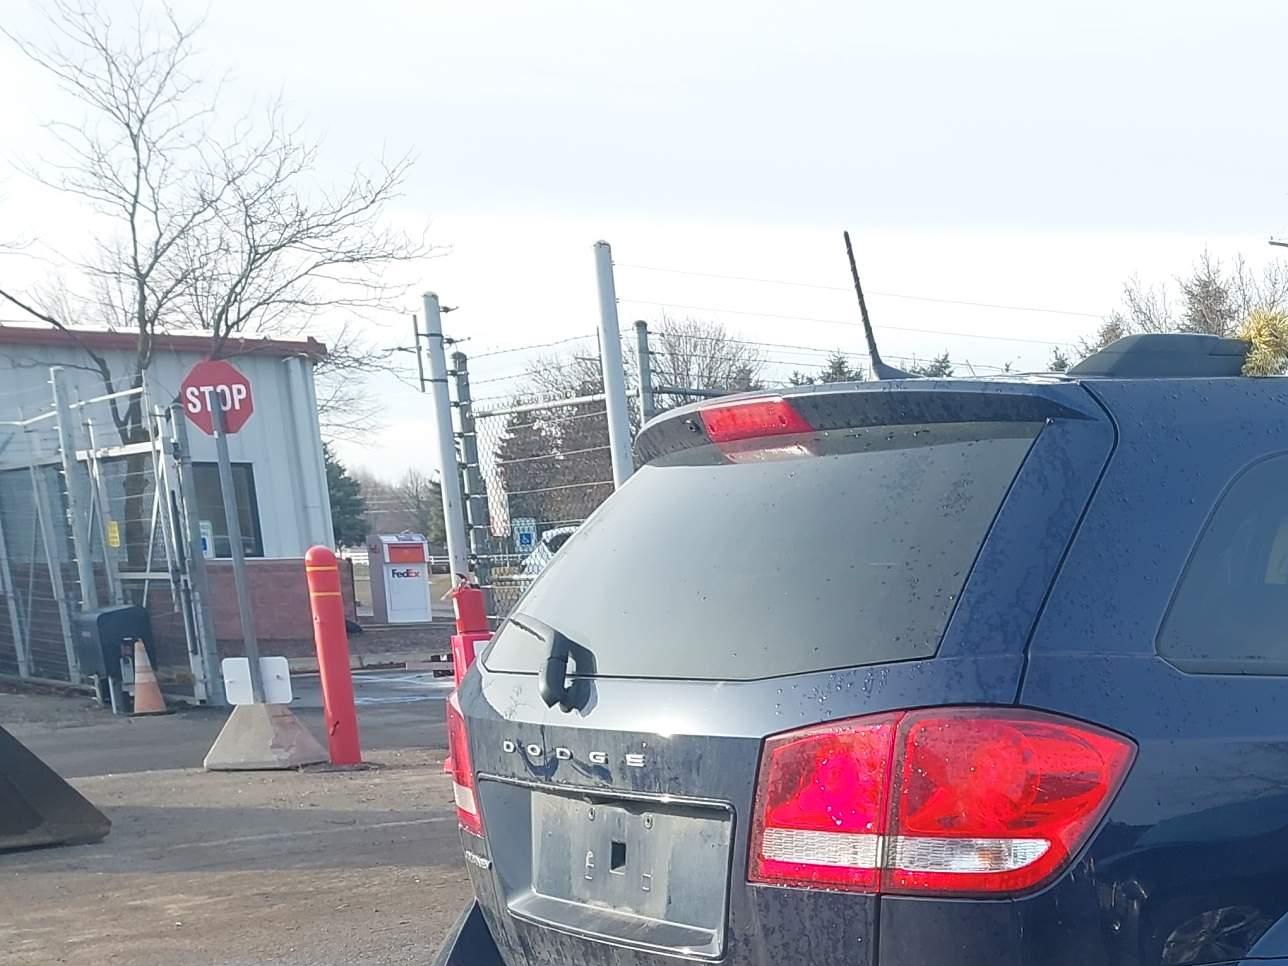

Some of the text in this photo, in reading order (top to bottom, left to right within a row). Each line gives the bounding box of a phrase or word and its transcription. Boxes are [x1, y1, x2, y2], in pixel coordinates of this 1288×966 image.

[186, 383, 247, 414] STOP
[391, 568, 420, 579] FedEx
[503, 739, 647, 768] DODGE
